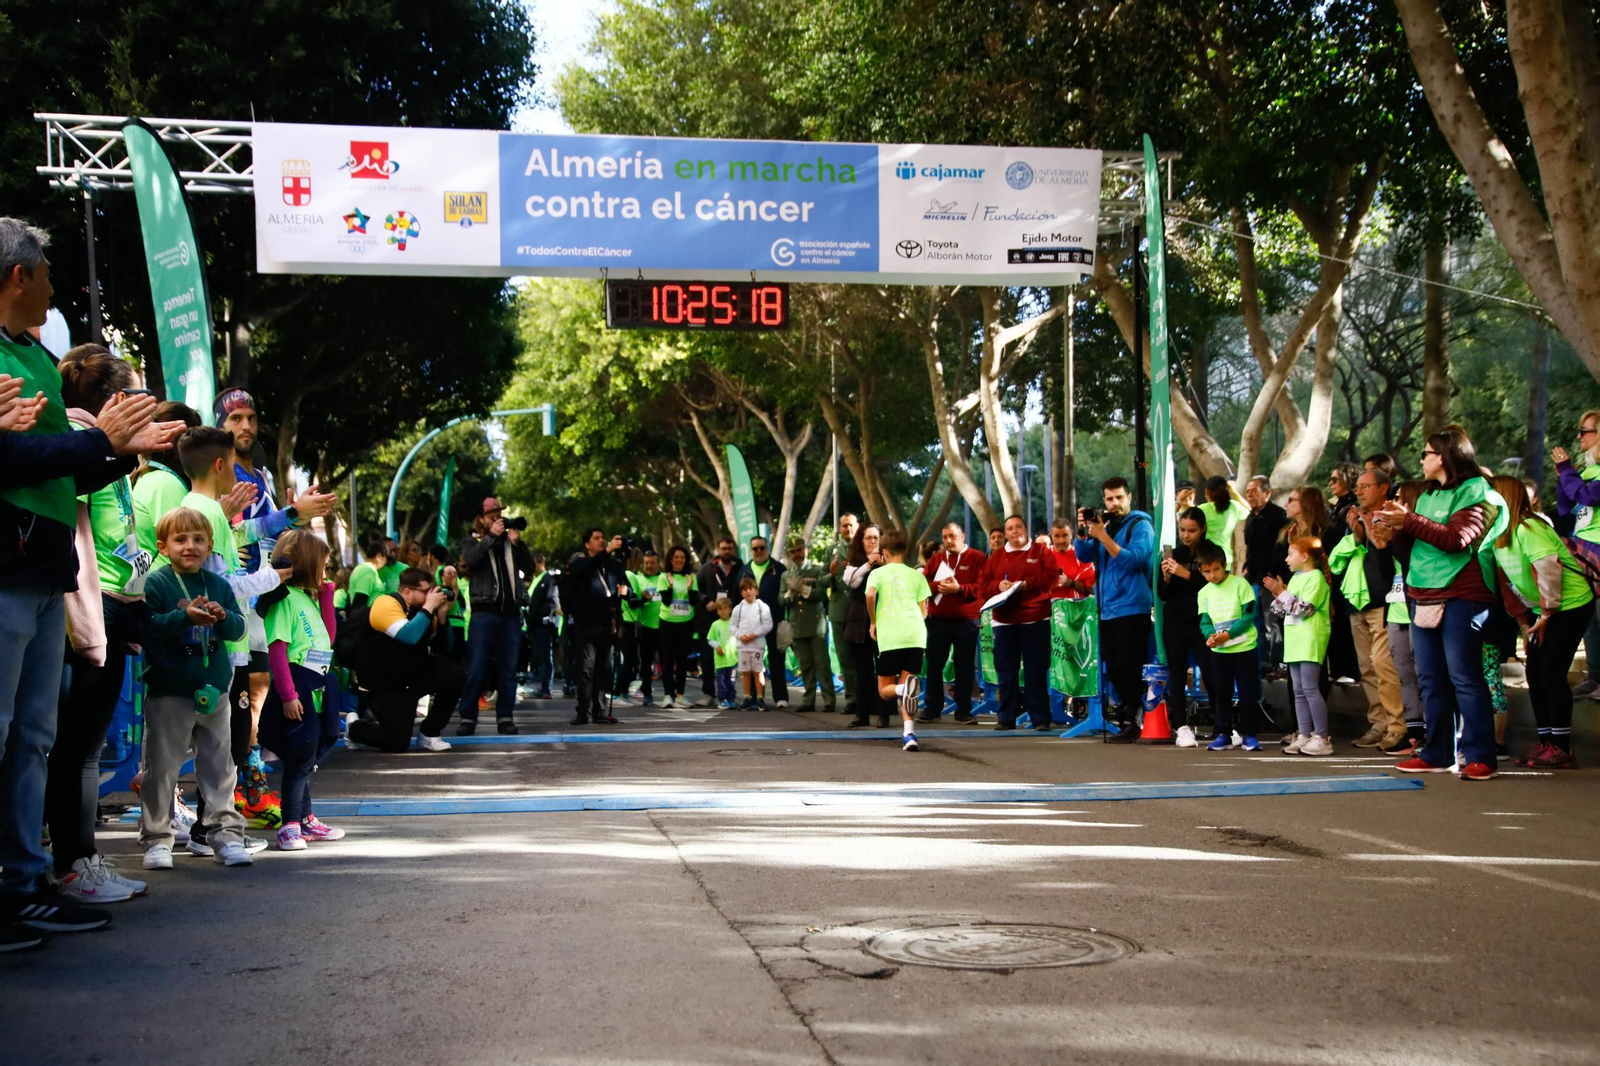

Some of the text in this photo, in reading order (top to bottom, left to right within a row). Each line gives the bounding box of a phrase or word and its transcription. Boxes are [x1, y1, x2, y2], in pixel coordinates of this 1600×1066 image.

[525, 148, 856, 184] Almería en marcha
[921, 164, 986, 182] cajamar
[1034, 169, 1089, 178] UNIVERSIDAD
[525, 191, 814, 222] contra el cáncer
[983, 206, 1058, 221] Fundación
[839, 241, 870, 249] española
[927, 240, 958, 249] Toyota
[1022, 233, 1082, 245] Ejido Motor
[516, 246, 632, 257] #TodosContraElCáncer
[927, 251, 992, 261] Alborán Motor
[652, 285, 782, 326] 10:25:18
